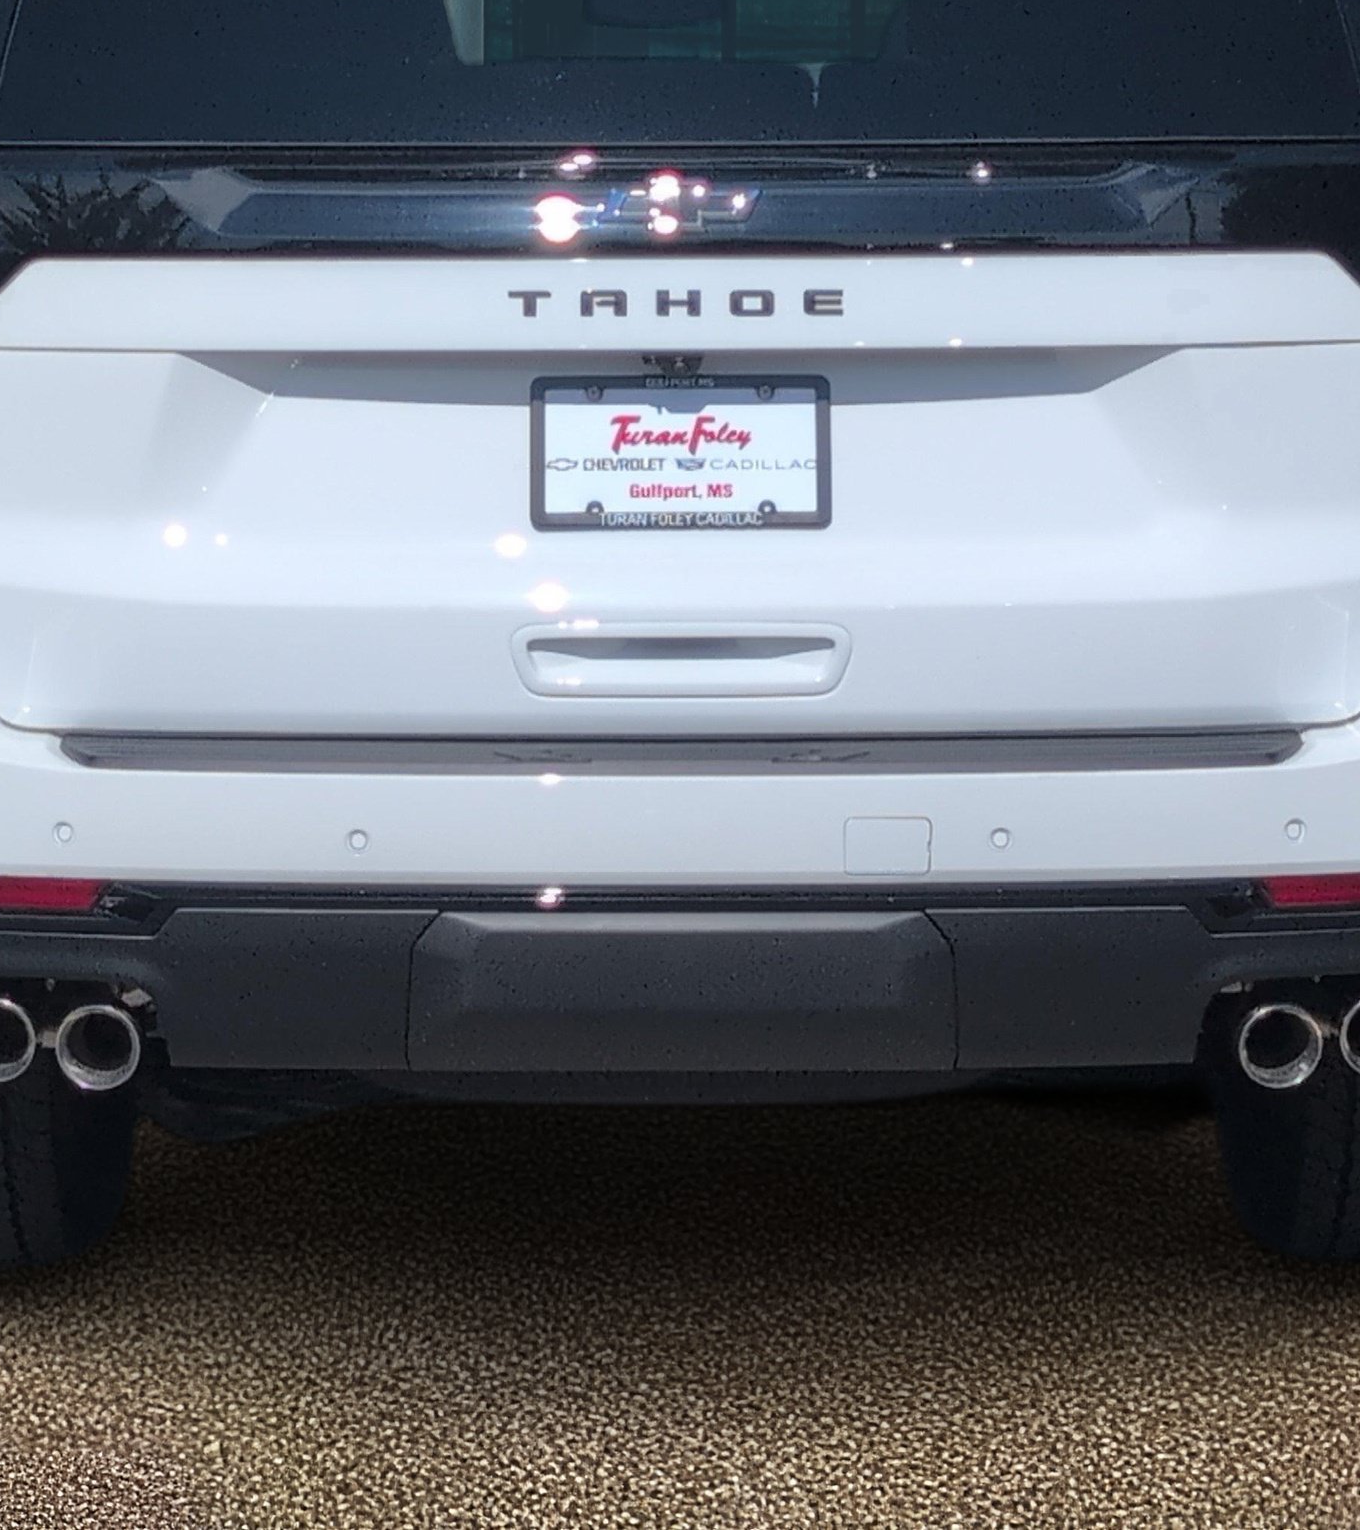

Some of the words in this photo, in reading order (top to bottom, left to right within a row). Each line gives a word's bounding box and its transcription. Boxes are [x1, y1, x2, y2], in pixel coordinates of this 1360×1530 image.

[507, 289, 845, 318] TAHOE
[610, 415, 689, 455] Turan
[687, 415, 752, 455] Foley
[582, 457, 666, 472] CHEVROLET
[709, 458, 818, 471] CADILLAC
[629, 483, 702, 501] Gulfport,
[707, 483, 734, 498] MS
[599, 511, 647, 526] TURAN
[650, 512, 693, 527] FOLEY
[695, 511, 764, 526] CADILLAC
